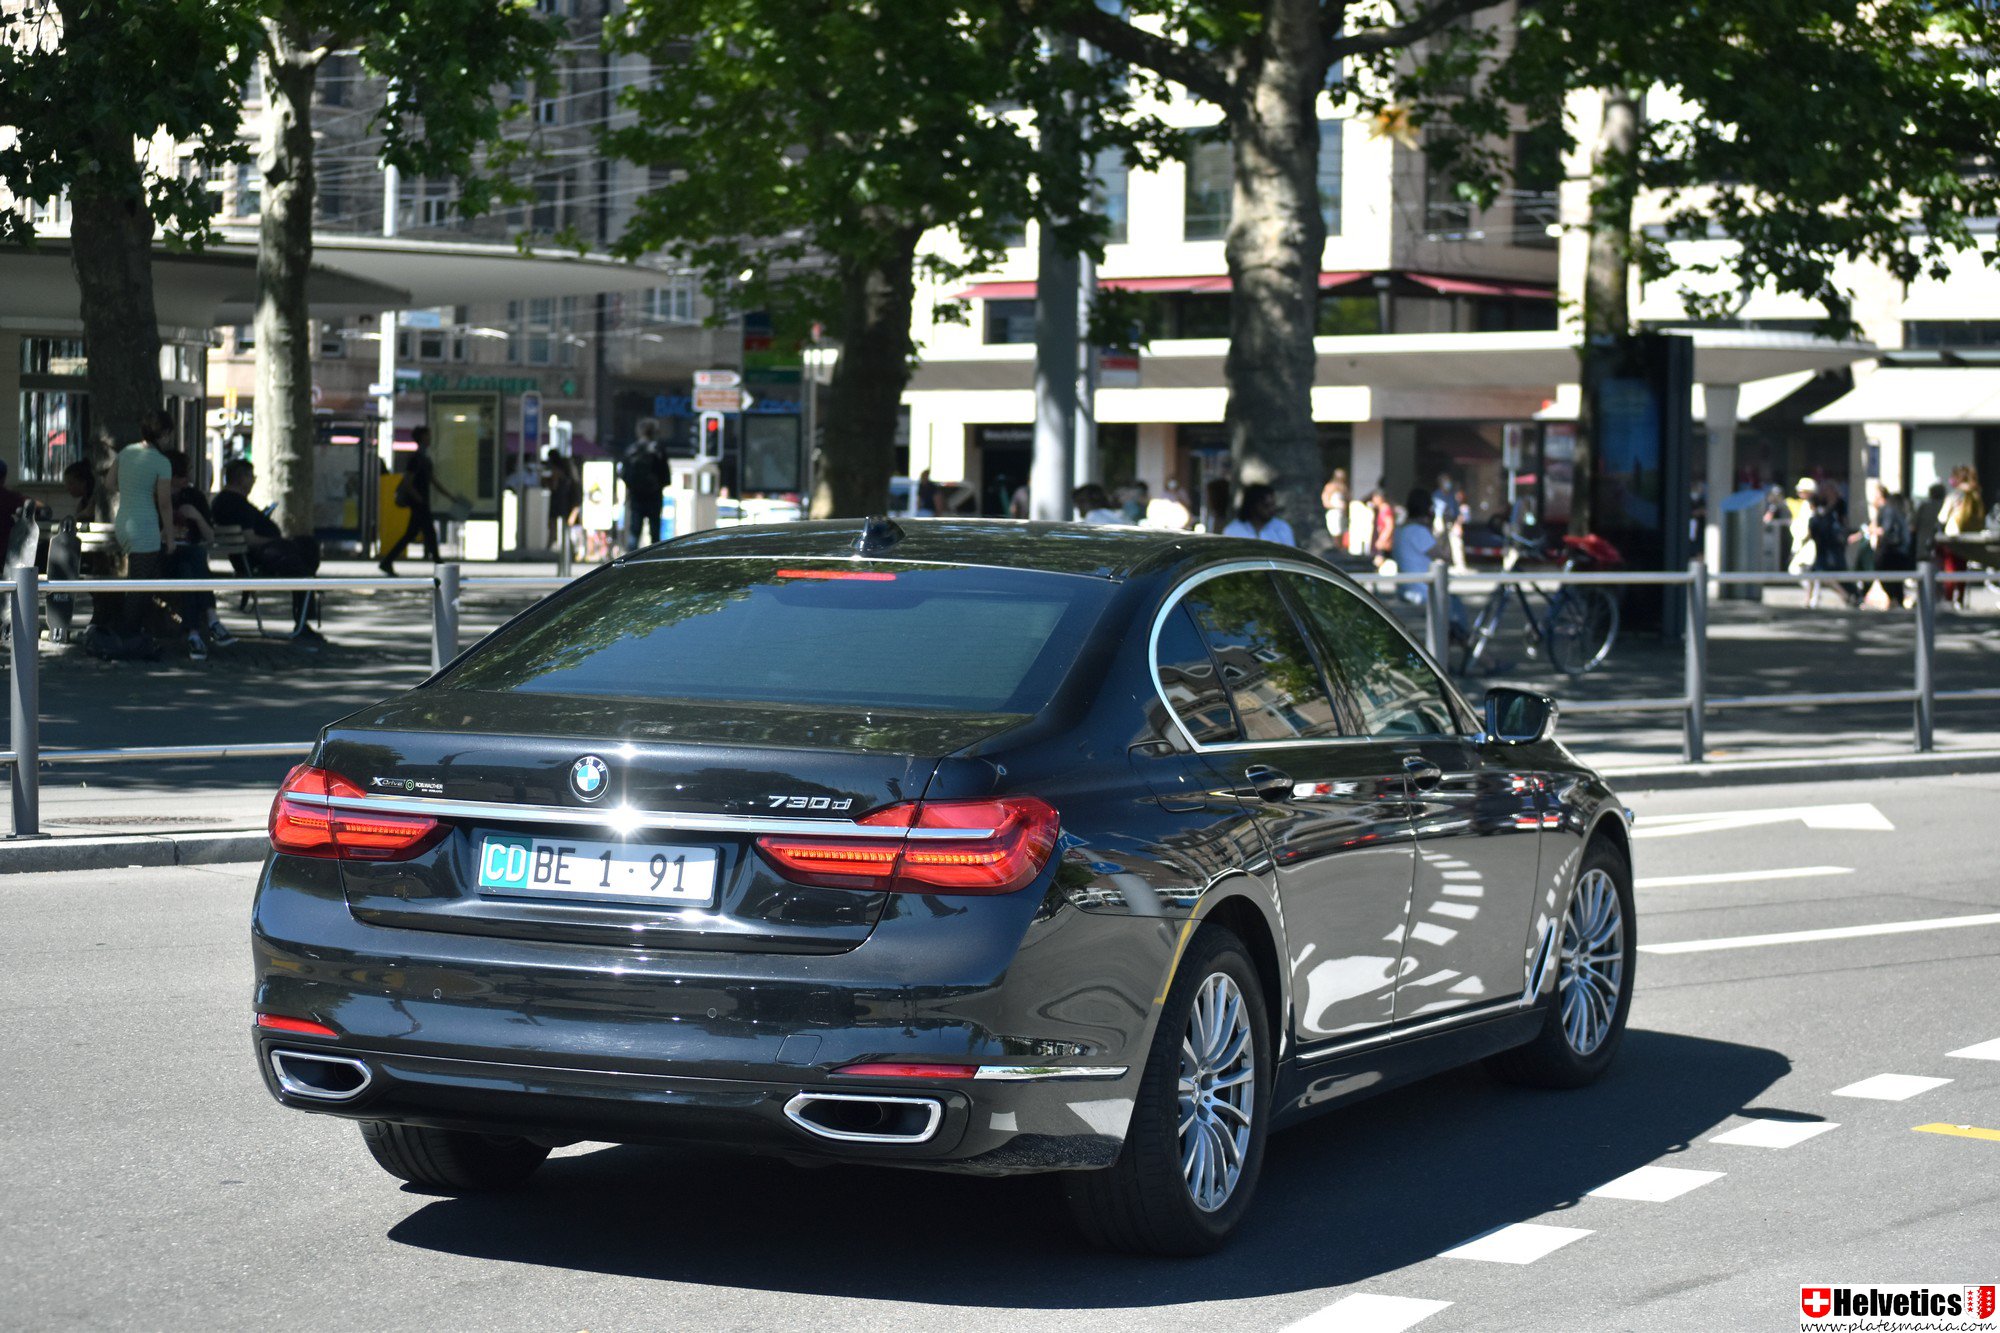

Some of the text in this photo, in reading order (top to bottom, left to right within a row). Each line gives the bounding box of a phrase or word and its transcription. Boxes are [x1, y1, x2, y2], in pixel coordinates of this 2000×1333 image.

[574, 757, 606, 773] BMW
[768, 795, 853, 810] 730d
[485, 843, 527, 882] CD
[534, 846, 576, 885] BE
